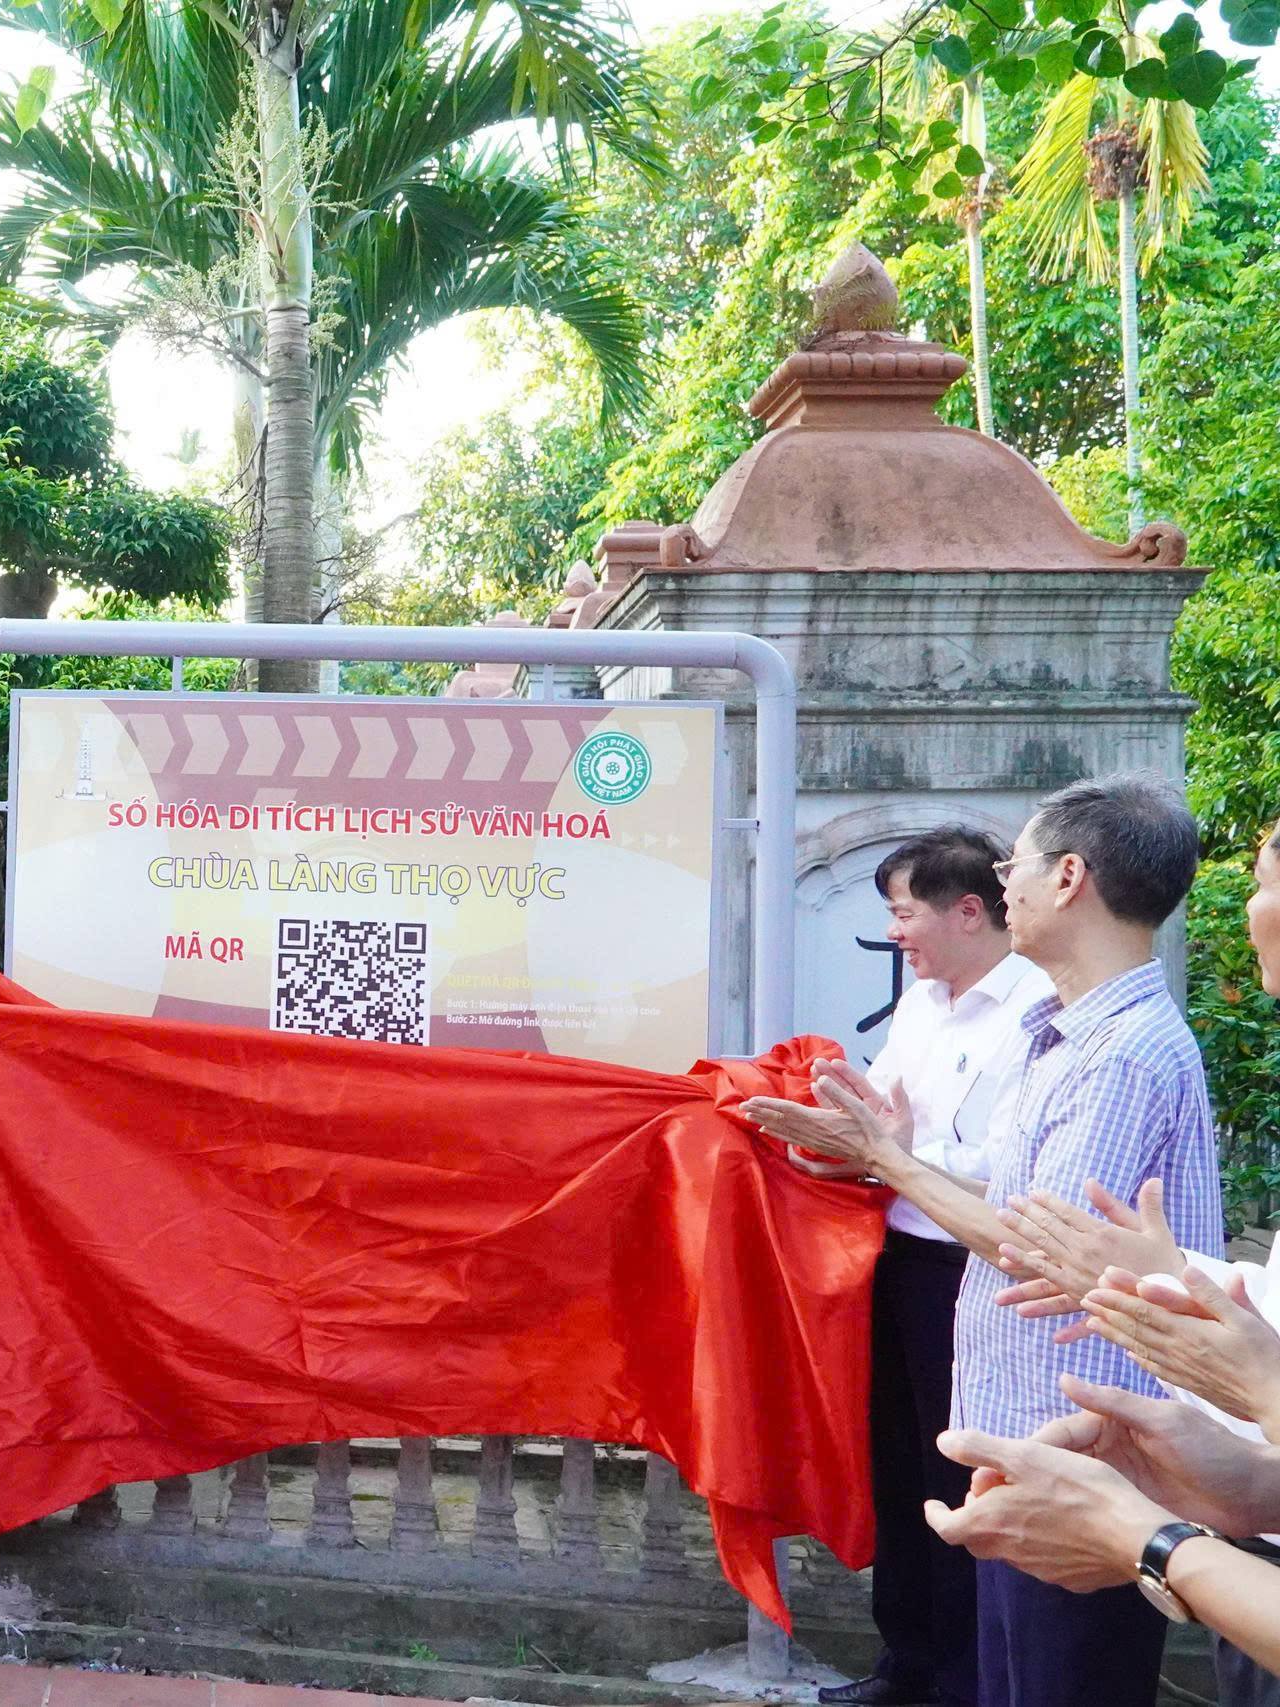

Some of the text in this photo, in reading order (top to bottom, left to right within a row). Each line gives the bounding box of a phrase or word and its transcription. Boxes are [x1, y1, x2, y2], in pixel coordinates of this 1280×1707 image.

[612, 785, 632, 798] NAM
[108, 796, 611, 840] SỐ HÓA DI TÍCH LỊCH SỬ VĂN HOÁ
[148, 852, 566, 907] CHÙA LÀNG THỌ VỰC
[165, 931, 244, 964] MÃ QR
[447, 999, 468, 1009] Bước
[480, 999, 508, 1011] Hướng
[511, 1001, 528, 1013] máy
[640, 1007, 661, 1016] code
[446, 1014, 468, 1024] Bước
[469, 1015, 477, 1024] 2:
[479, 1014, 493, 1025] Mở
[494, 1016, 522, 1028] đường
[523, 1016, 539, 1027] link
